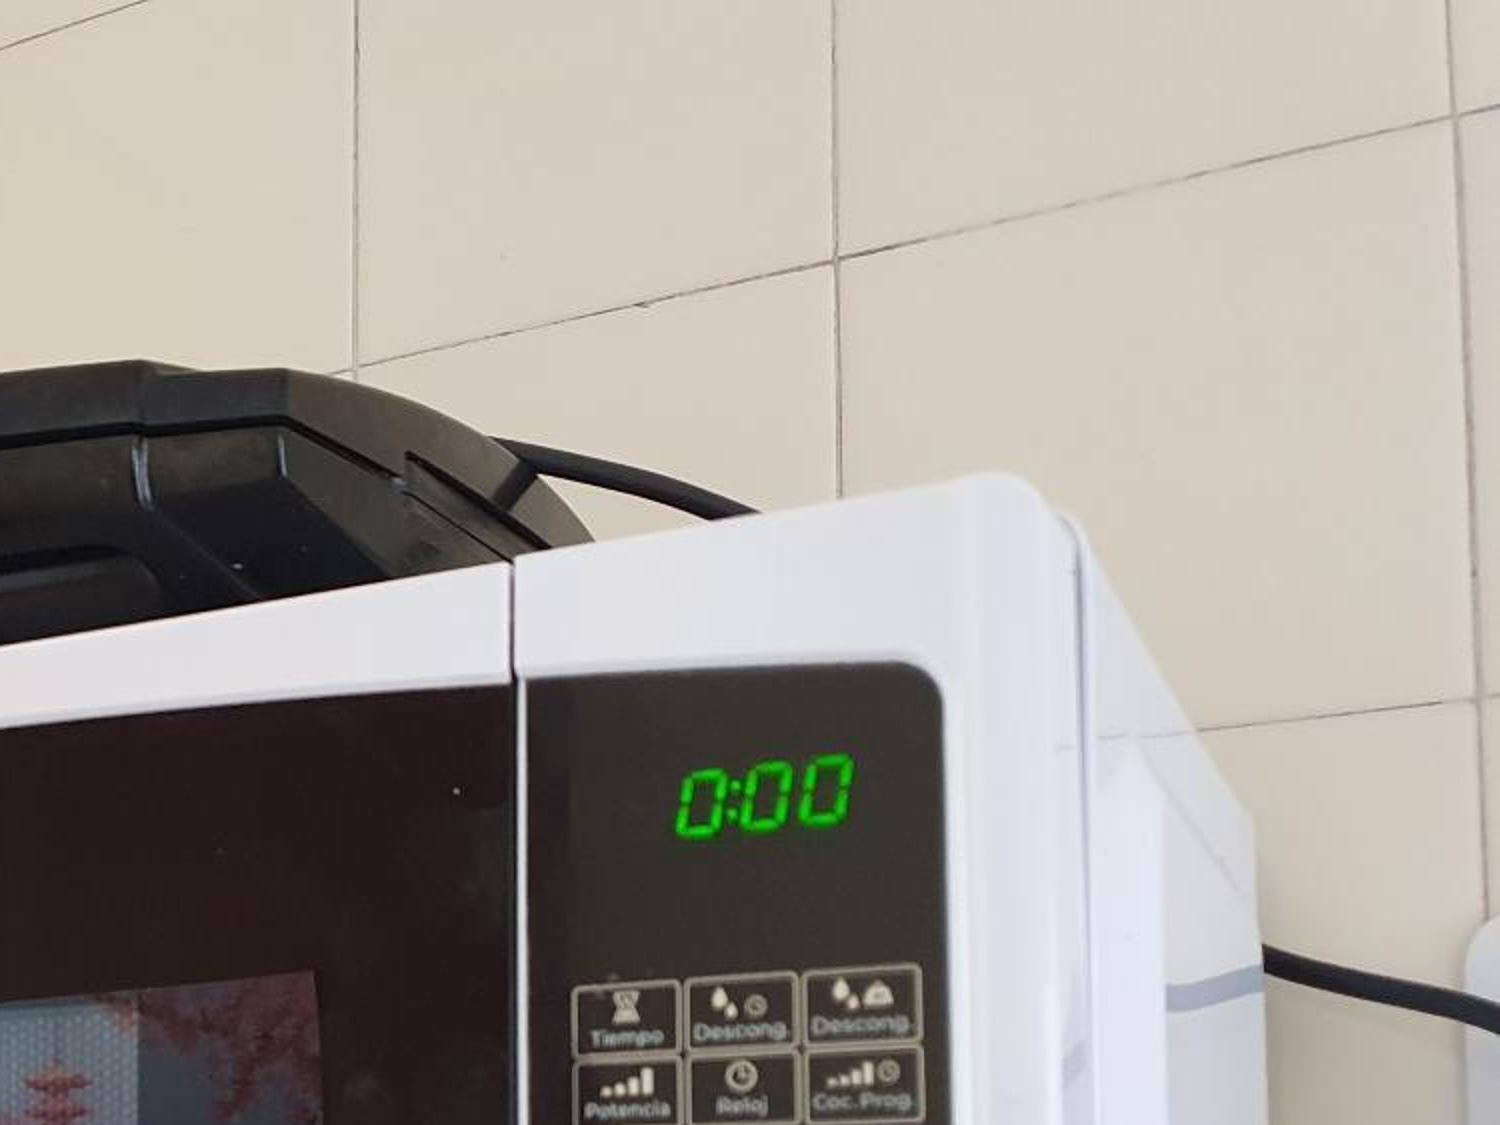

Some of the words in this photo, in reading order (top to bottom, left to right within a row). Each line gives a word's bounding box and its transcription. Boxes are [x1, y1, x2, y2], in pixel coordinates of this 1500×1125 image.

[676, 754, 854, 839] 0:00
[590, 1028, 665, 1047] Tiempo
[583, 1101, 671, 1120] Potencia
[715, 1096, 769, 1116] Reloj
